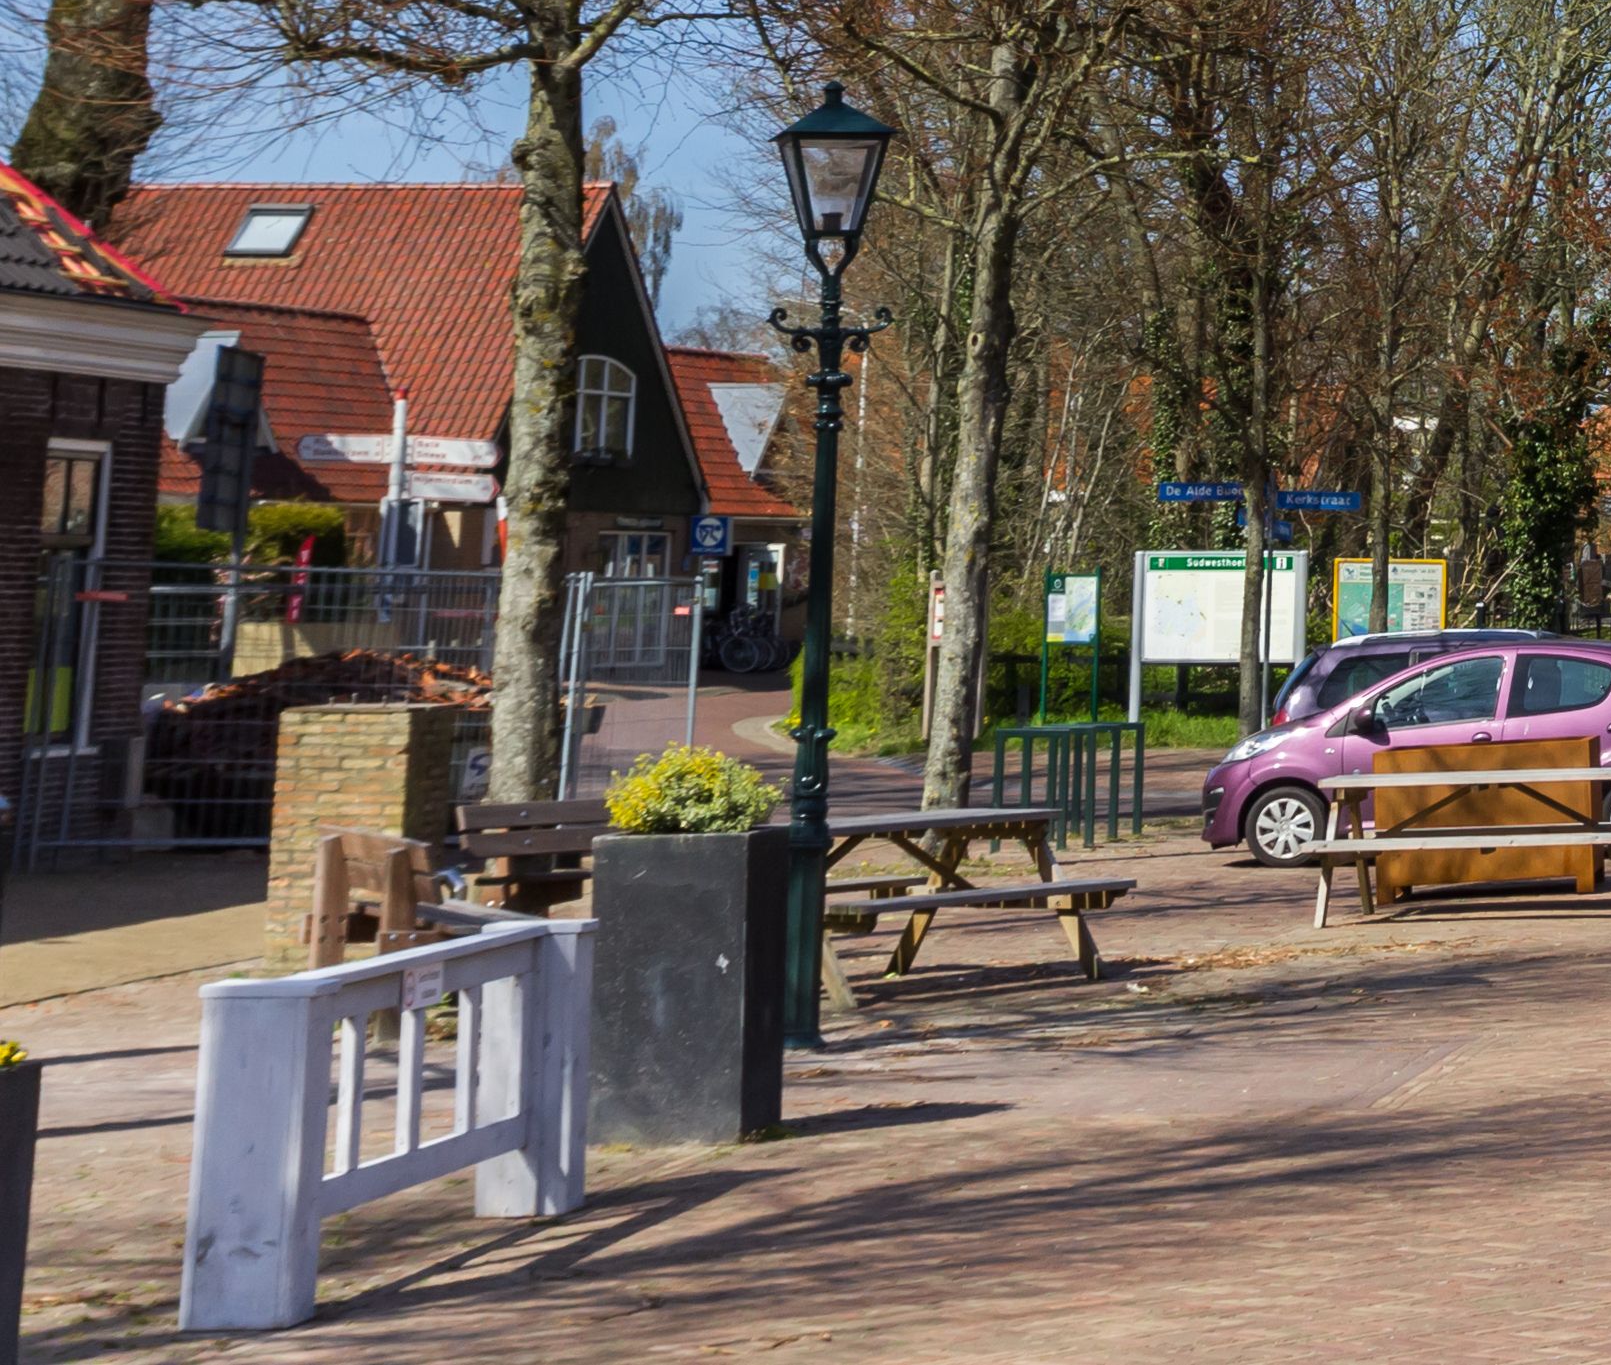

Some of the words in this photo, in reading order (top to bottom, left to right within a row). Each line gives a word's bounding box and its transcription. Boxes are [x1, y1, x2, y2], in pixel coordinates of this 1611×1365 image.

[1166, 486, 1181, 496] De
[1185, 486, 1212, 496] Alde
[1216, 486, 1245, 496] Buor
[1286, 494, 1351, 506] Kerkstraat
